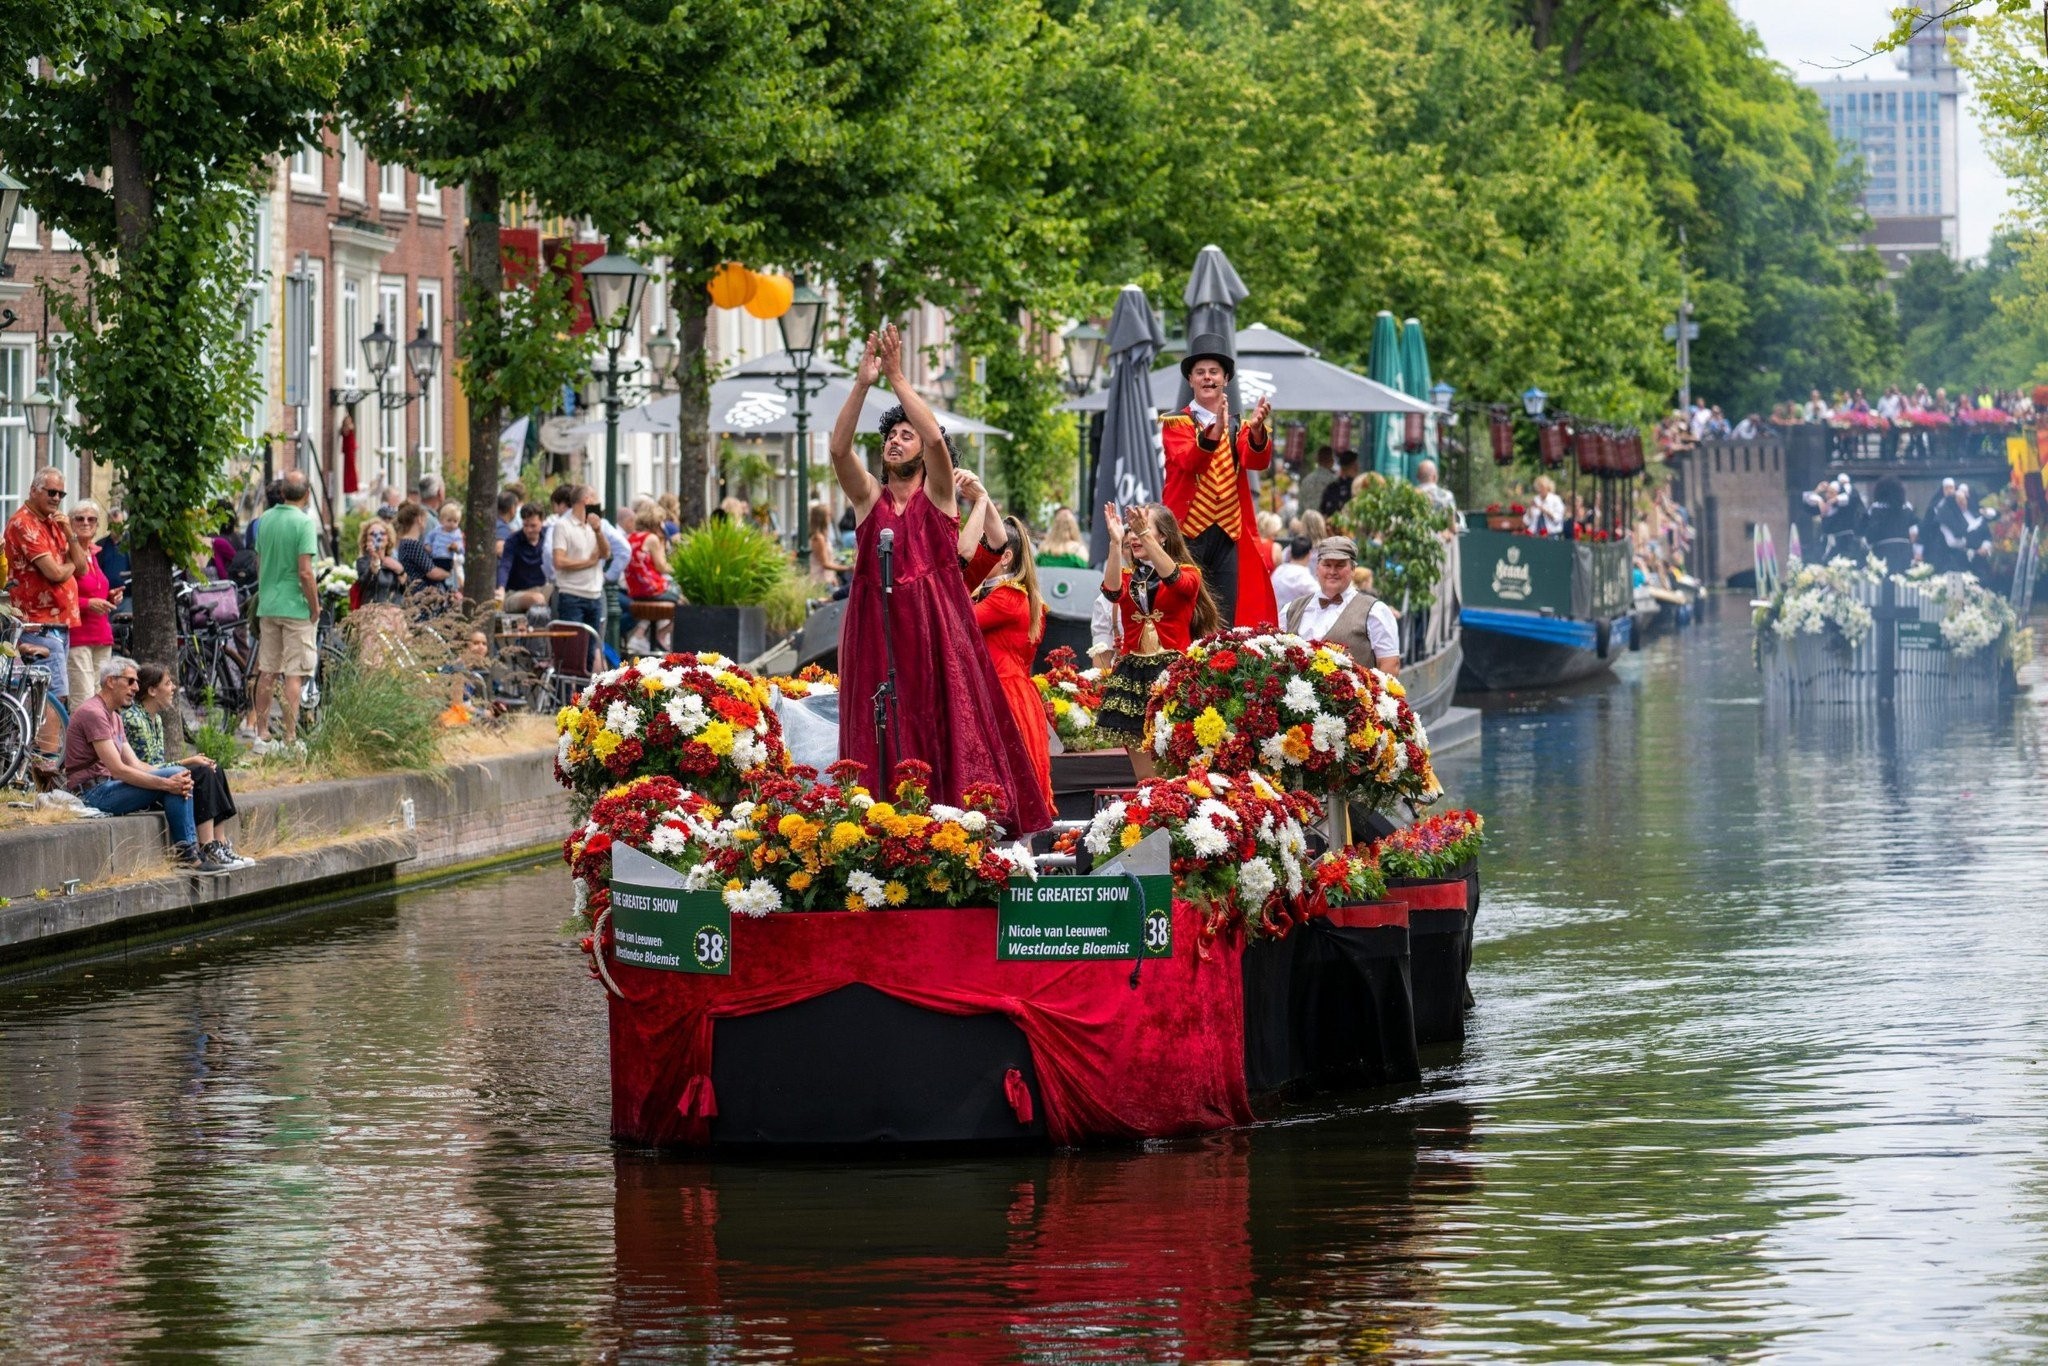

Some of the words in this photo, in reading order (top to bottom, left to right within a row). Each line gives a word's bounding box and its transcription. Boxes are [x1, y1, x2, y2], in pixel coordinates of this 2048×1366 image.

[1010, 887, 1033, 902] THE
[1037, 887, 1094, 902] GREATEST
[1096, 886, 1129, 901] SHOW
[621, 892, 651, 911] GREATEST
[652, 897, 679, 913] SHOW
[1008, 924, 1041, 938] Nicole
[1043, 927, 1063, 938] van
[1147, 917, 1168, 946] 38
[696, 932, 724, 962] 38
[1008, 942, 1080, 955] Westlandse
[1082, 941, 1130, 955] Bloemist
[644, 950, 680, 966] Bloemist
